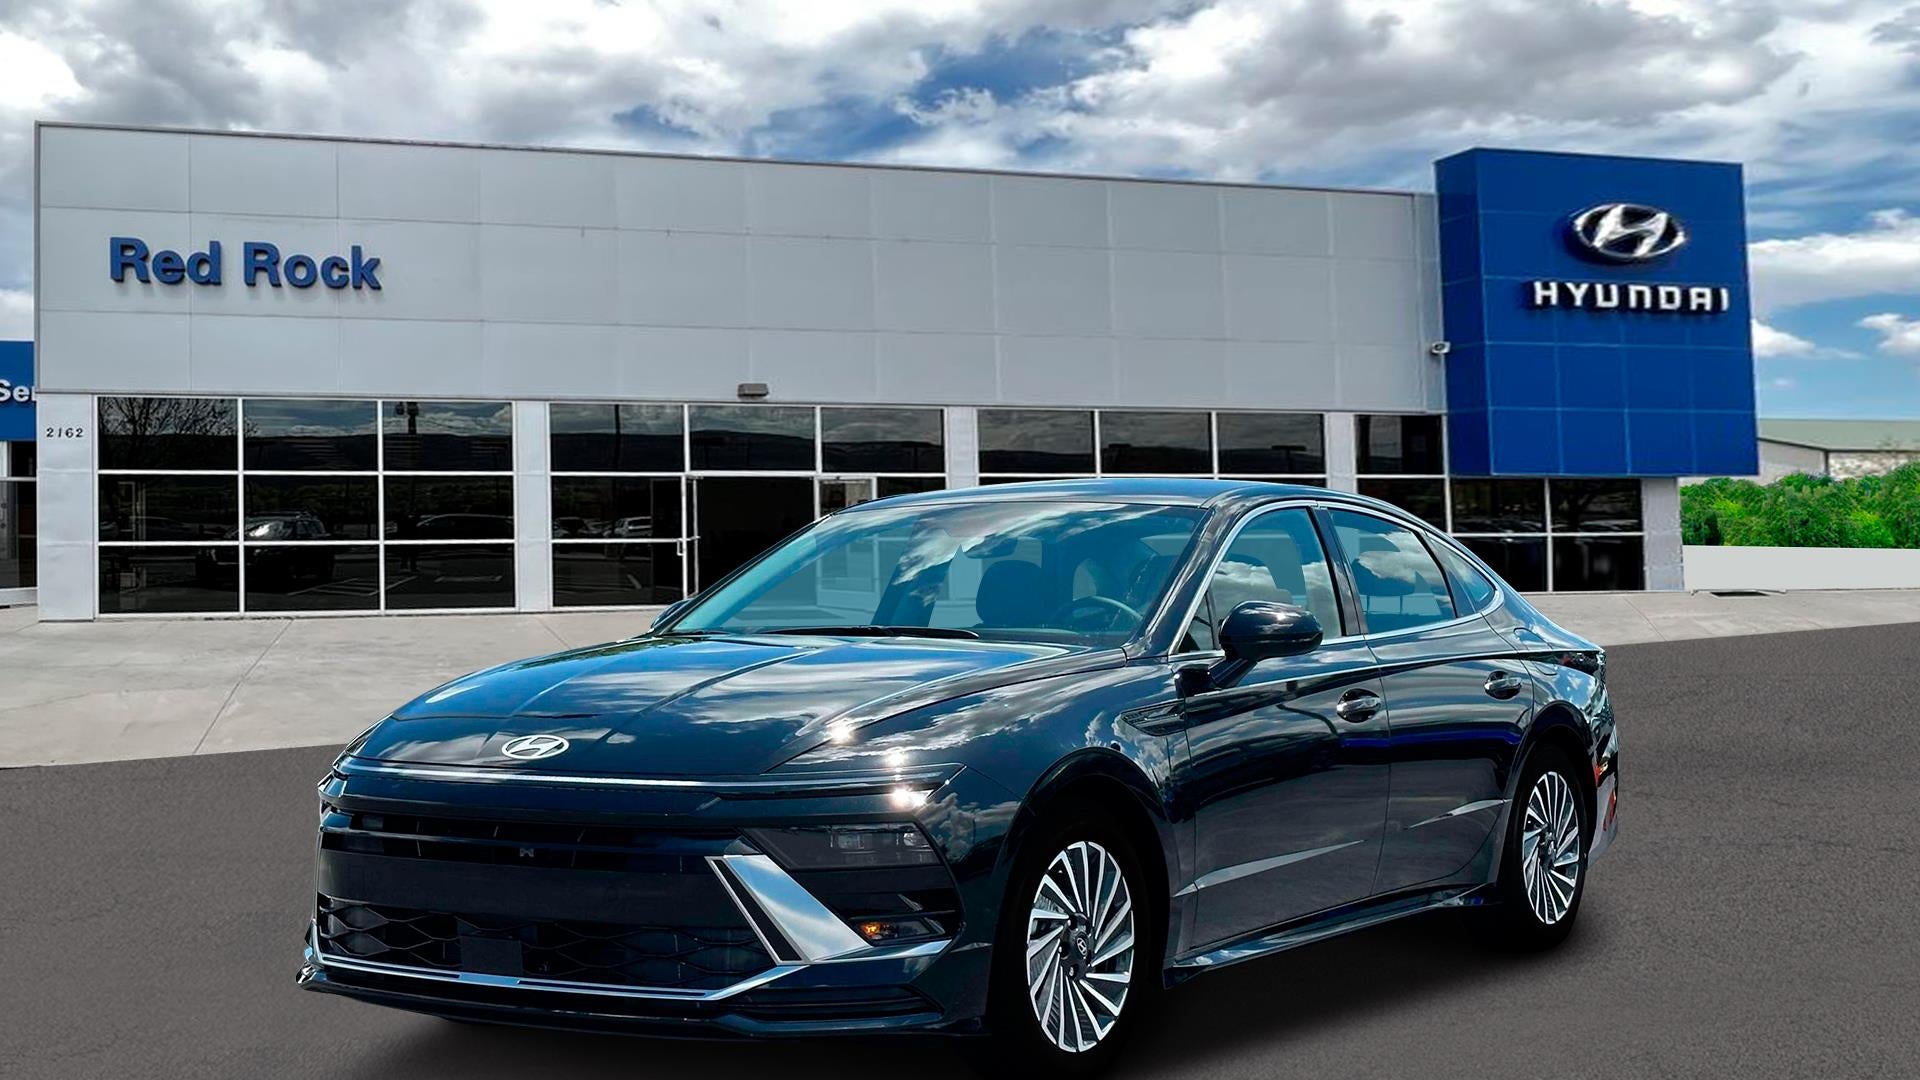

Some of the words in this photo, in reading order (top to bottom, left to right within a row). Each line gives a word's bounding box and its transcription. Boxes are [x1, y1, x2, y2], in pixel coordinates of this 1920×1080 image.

[110, 237, 221, 286] Red
[243, 241, 382, 290] Rock
[1533, 281, 1729, 312] HYUNDAI
[46, 427, 83, 438] 2162
